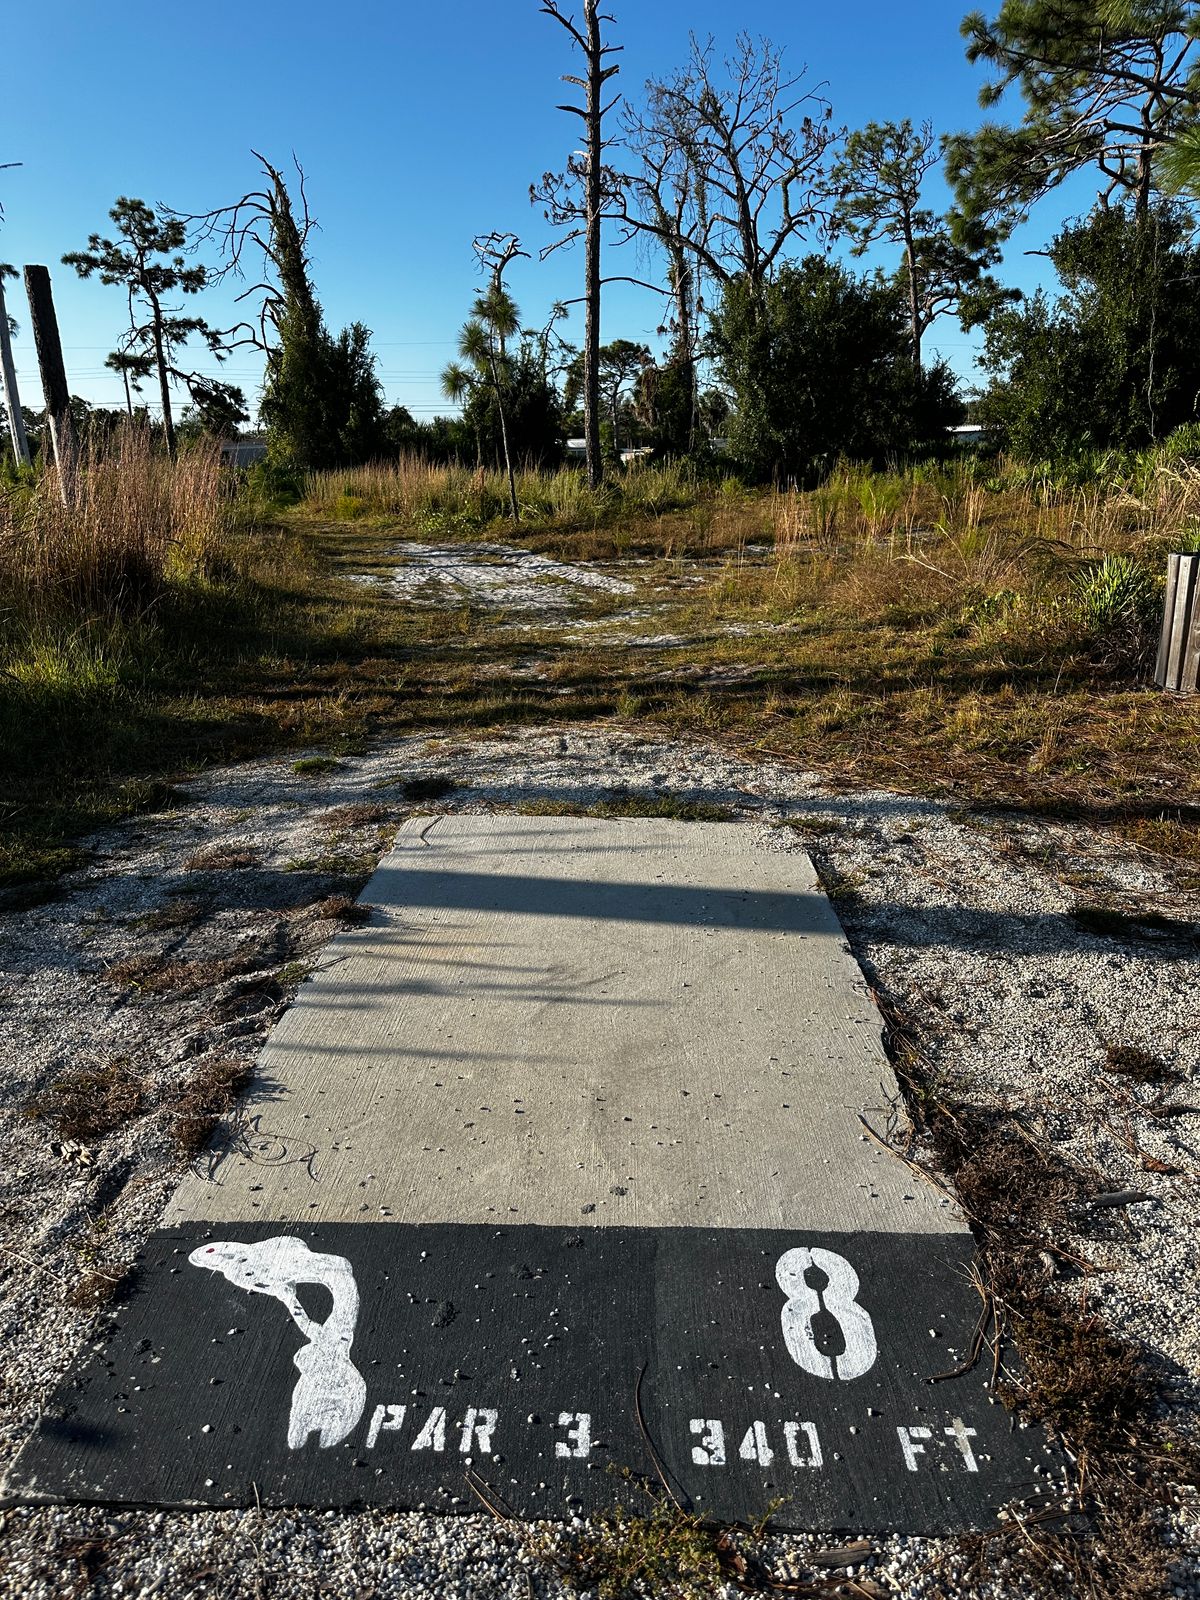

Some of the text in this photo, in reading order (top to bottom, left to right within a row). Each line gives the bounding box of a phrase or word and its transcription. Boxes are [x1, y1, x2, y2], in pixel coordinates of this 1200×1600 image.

[775, 1247, 879, 1381] 8
[366, 1404, 498, 1453] PAR
[555, 1412, 592, 1458] 3
[690, 1418, 823, 1471] 340
